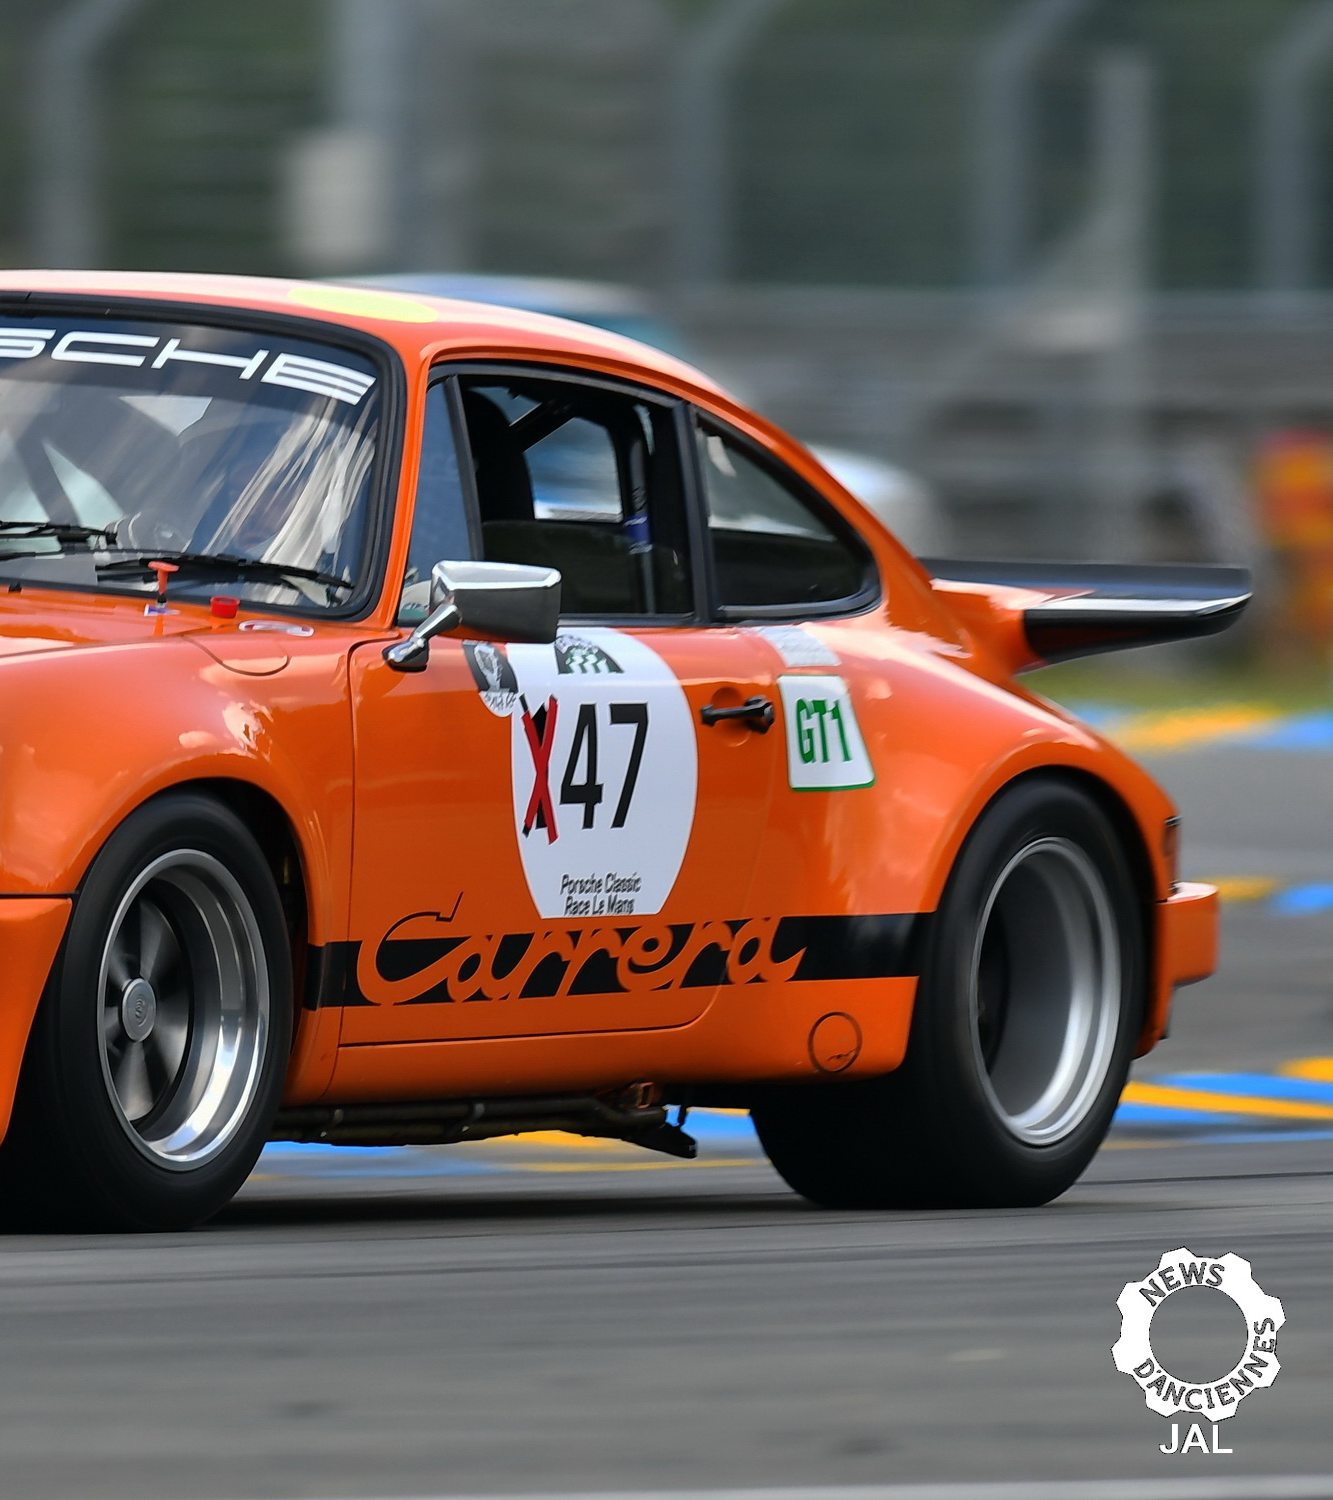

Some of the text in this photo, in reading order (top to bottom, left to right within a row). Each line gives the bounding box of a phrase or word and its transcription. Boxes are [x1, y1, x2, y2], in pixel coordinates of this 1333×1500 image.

[796, 698, 853, 764] GT1
[560, 871, 642, 895] Porsche Classic
[564, 893, 635, 917] Race Le Mans
[356, 891, 807, 1005] Carrera
